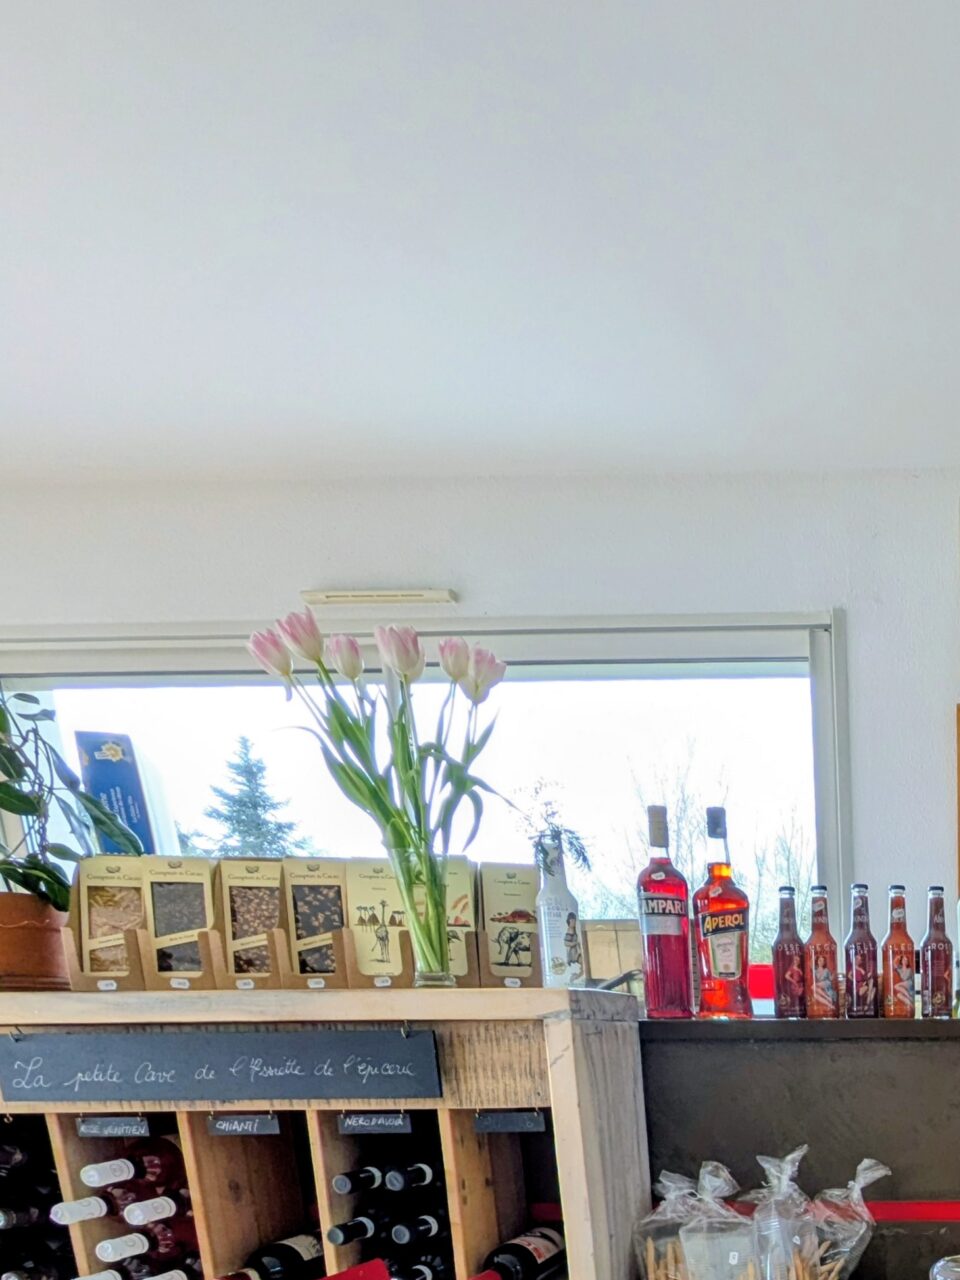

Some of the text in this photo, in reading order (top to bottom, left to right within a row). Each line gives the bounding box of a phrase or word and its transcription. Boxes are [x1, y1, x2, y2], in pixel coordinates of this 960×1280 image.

[642, 898, 686, 914] AMPARI
[704, 914, 744, 933] APEROL
[13, 1056, 51, 1089] La
[63, 1064, 124, 1092] petite
[134, 1062, 176, 1084] Cave
[194, 1064, 216, 1080] de
[314, 1059, 334, 1076] de
[343, 1056, 416, 1084] l'épicerie
